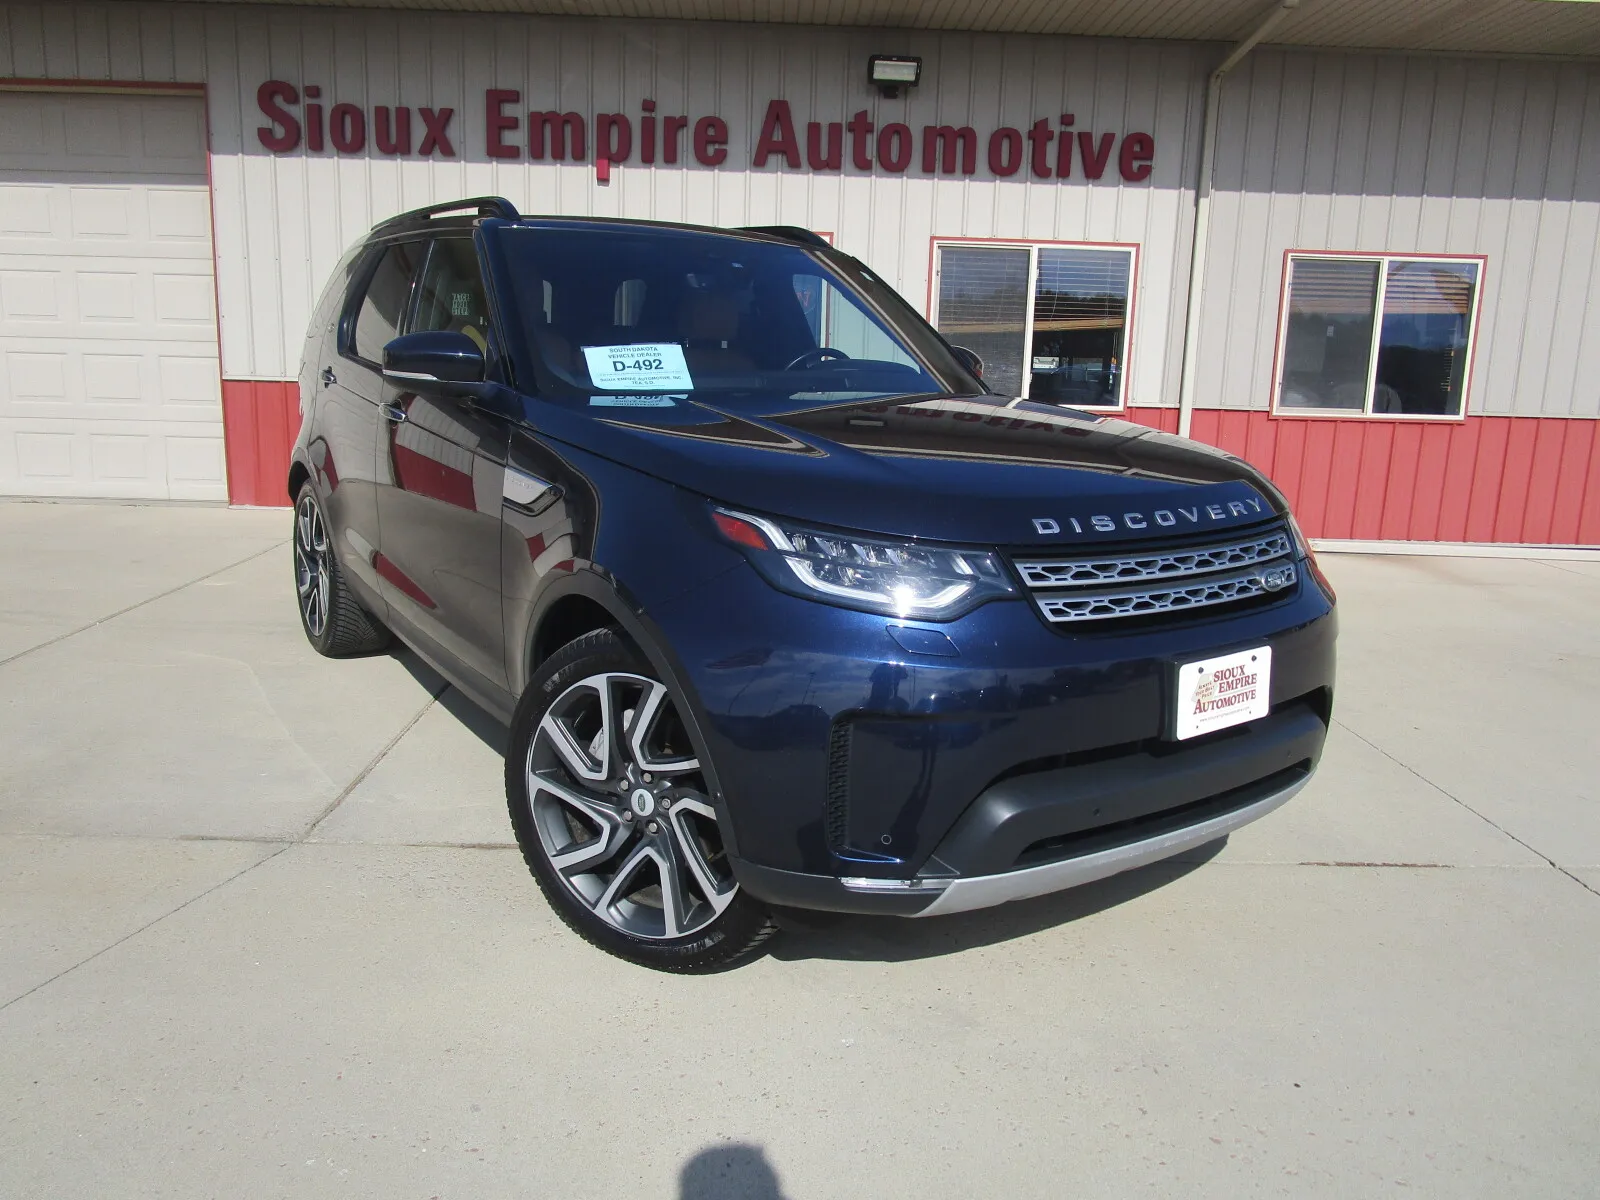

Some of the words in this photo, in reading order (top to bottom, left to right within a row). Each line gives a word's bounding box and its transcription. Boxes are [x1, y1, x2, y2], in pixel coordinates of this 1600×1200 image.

[257, 80, 456, 157] Sioux
[486, 89, 728, 186] Empire
[753, 99, 1154, 182] Automotive
[612, 359, 664, 371] D-492
[1032, 497, 1263, 535] DISCOVERY
[1213, 664, 1245, 682] SIOUX
[1218, 673, 1257, 693] EMPIRE
[1193, 689, 1256, 715] AUTOMOTIVE
